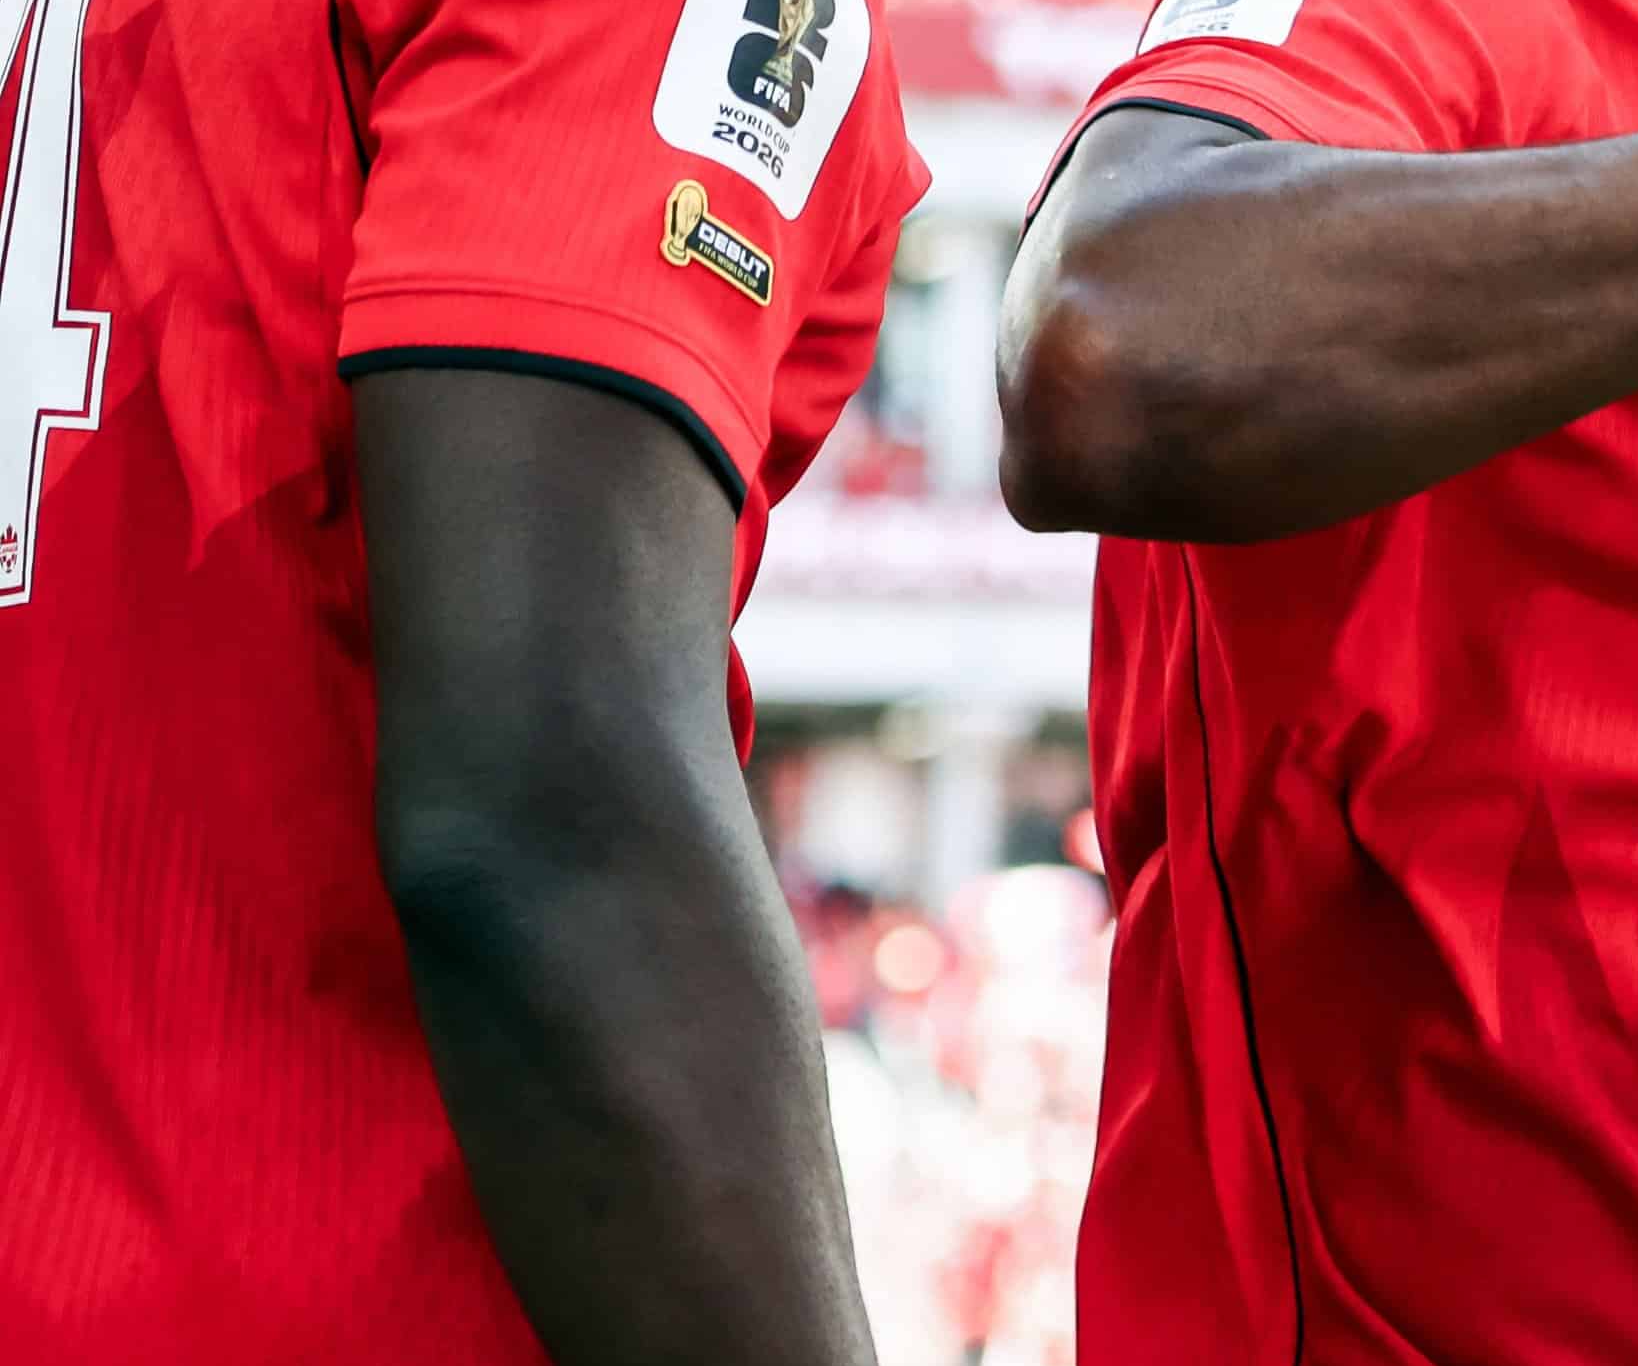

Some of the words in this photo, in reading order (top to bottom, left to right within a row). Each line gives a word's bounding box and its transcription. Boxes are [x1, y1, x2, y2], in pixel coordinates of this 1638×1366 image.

[753, 76, 791, 113] FIFA
[712, 120, 784, 179] 2026
[719, 103, 773, 137] WORLD
[773, 132, 790, 155] CUP
[698, 221, 767, 279] DEBUT
